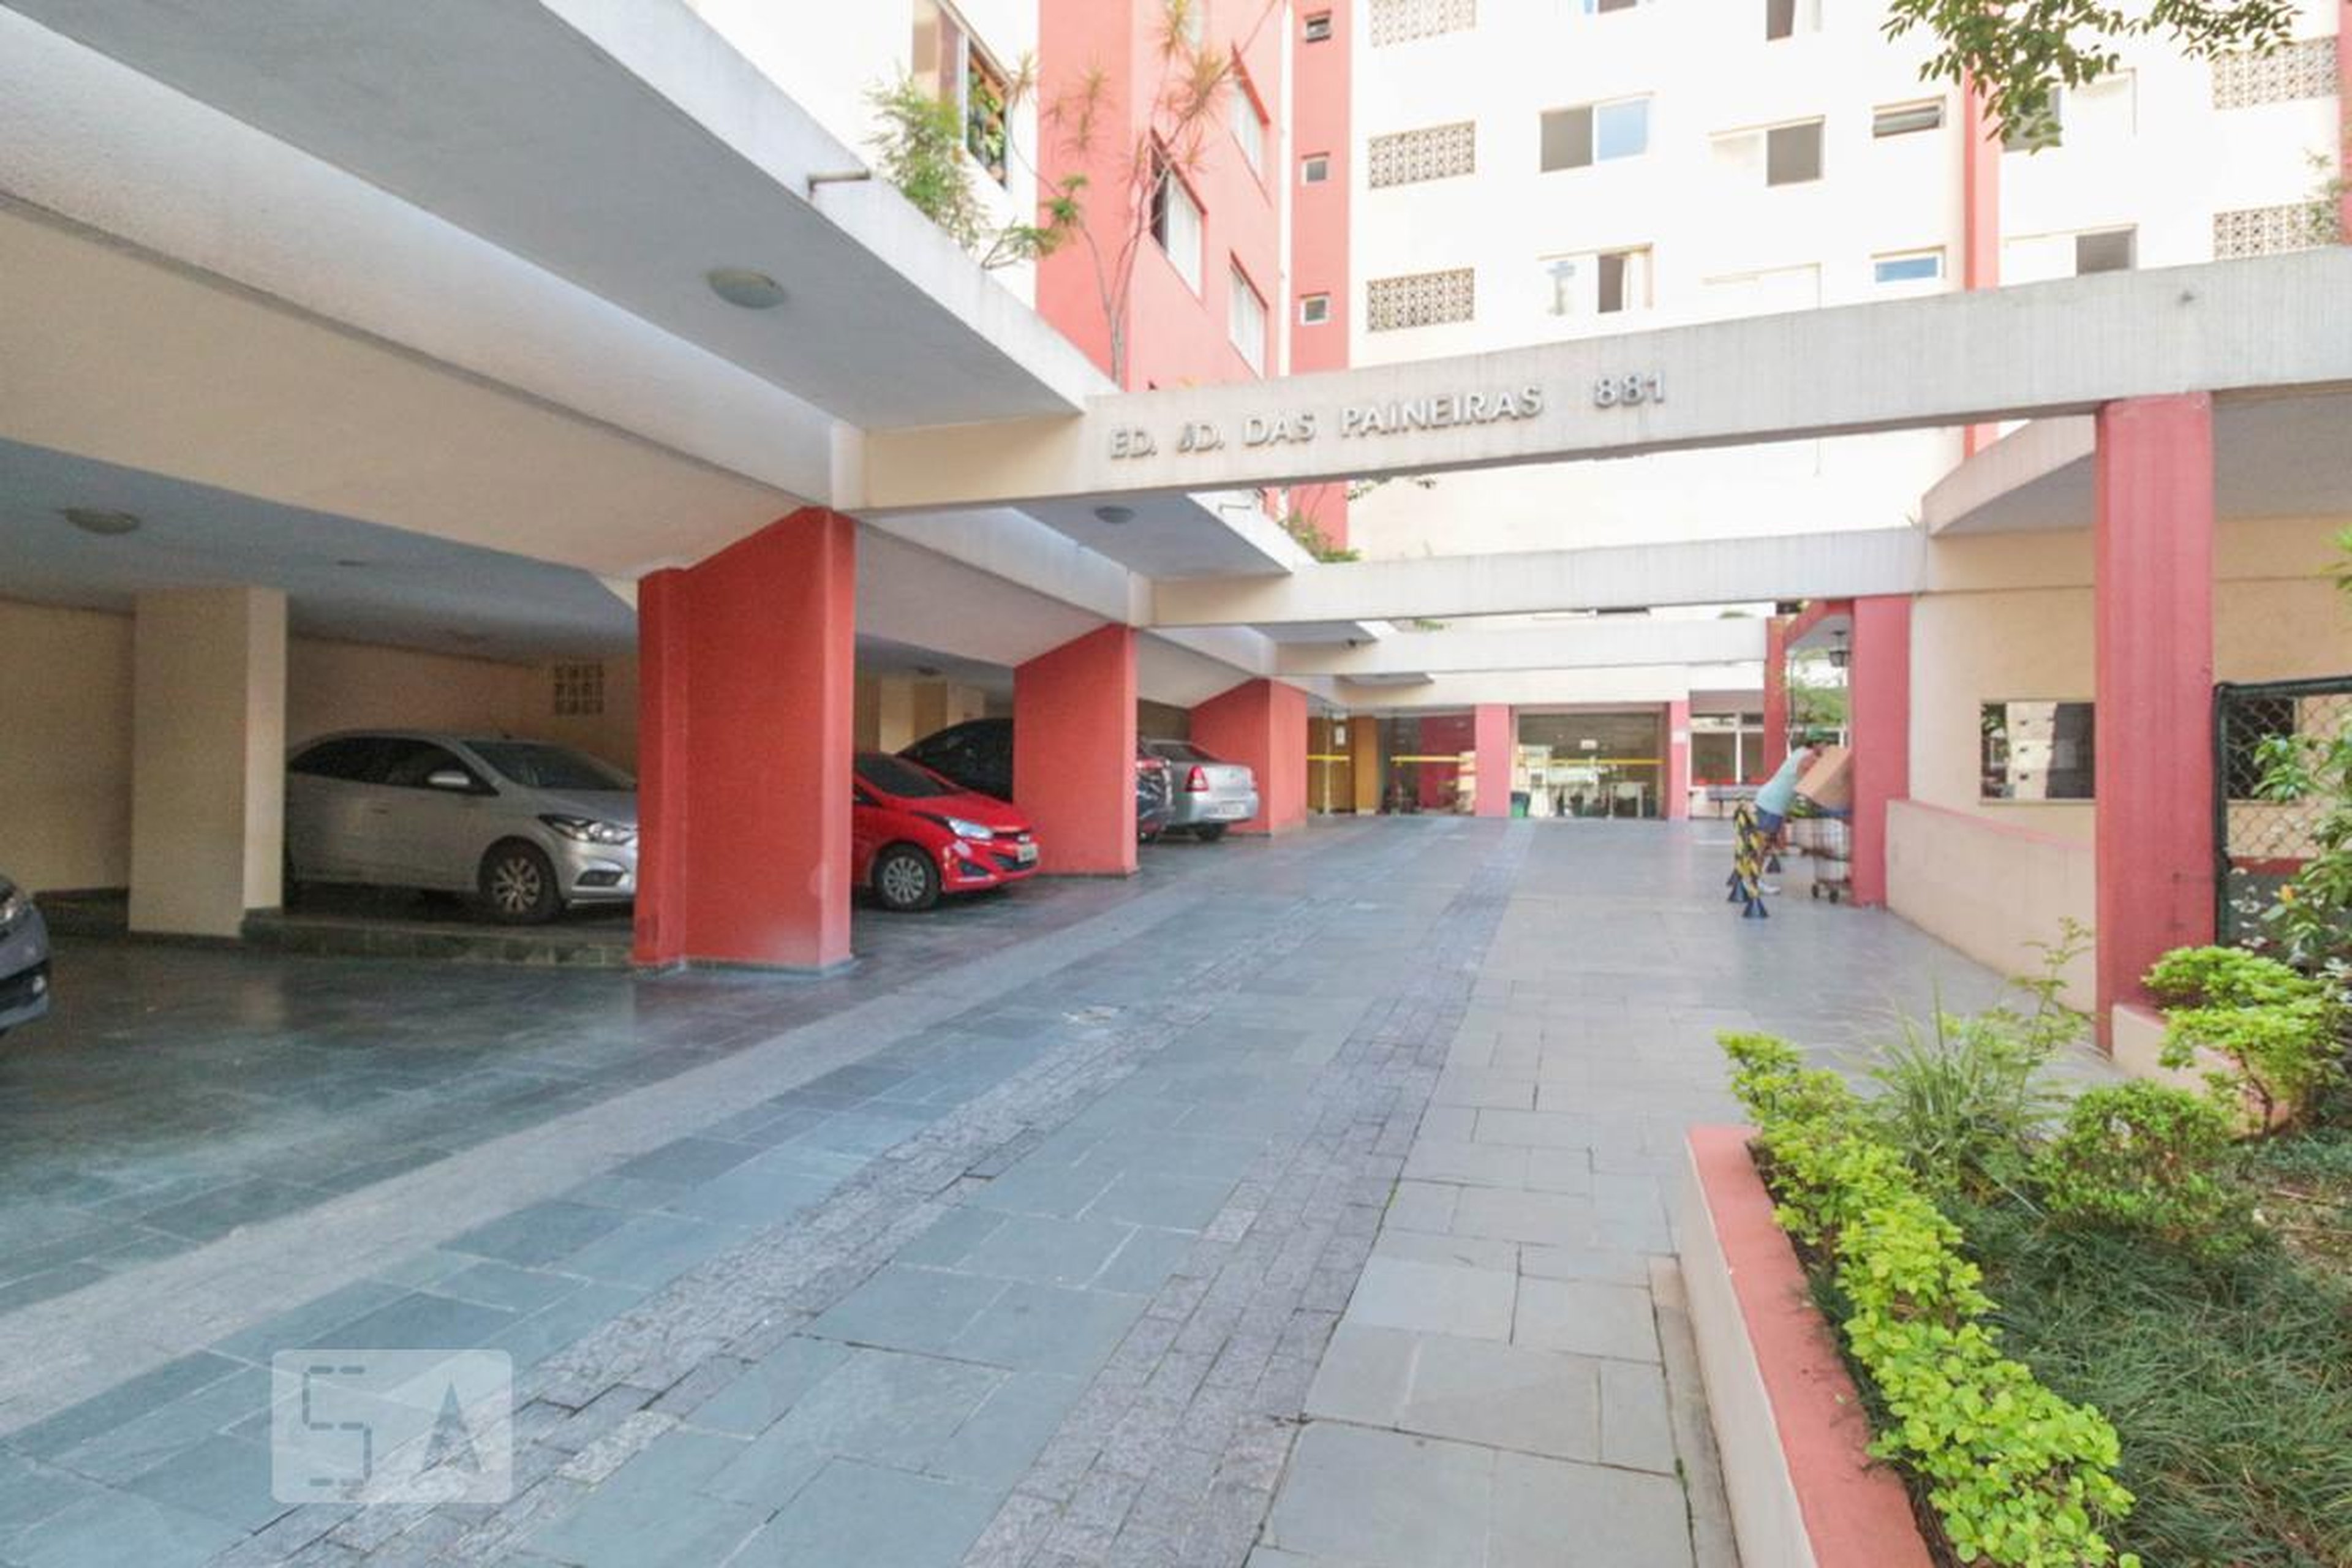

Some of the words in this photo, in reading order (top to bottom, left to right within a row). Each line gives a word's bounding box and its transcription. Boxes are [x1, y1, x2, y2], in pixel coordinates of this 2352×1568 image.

[1109, 427, 1157, 458] ED.
[1242, 412, 1315, 447] DAS
[1340, 385, 1544, 437] PAINEIRAS
[1594, 371, 1664, 408] 881
